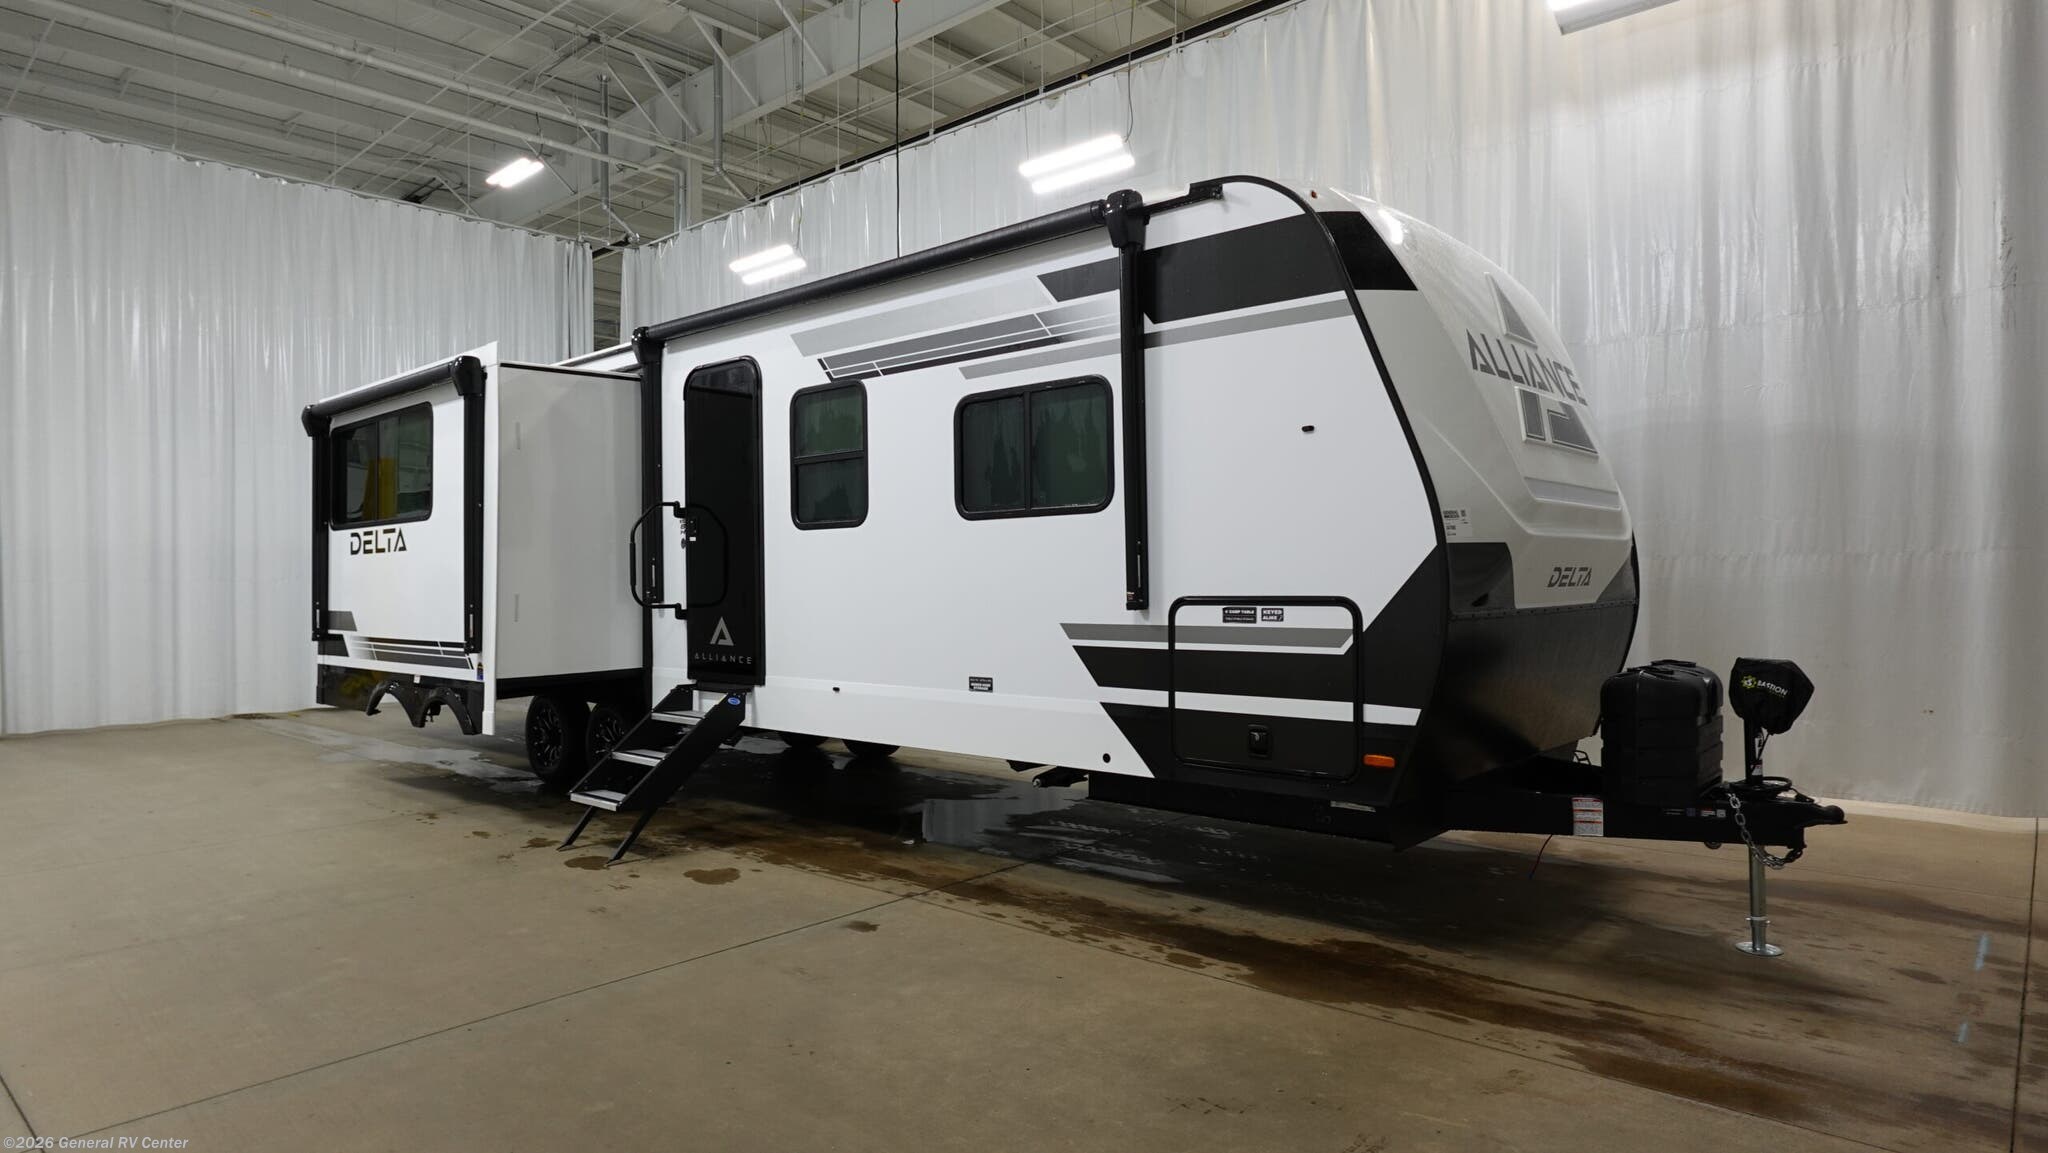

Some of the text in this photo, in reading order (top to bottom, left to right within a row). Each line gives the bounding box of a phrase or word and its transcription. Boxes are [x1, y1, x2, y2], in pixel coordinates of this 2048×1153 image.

[1466, 328, 1588, 406] ALLIANCE
[350, 528, 407, 555] DELTA
[1547, 566, 1592, 588] DELTA
[694, 652, 752, 665] ALLIANCE
[1757, 680, 1788, 696] BASTION
